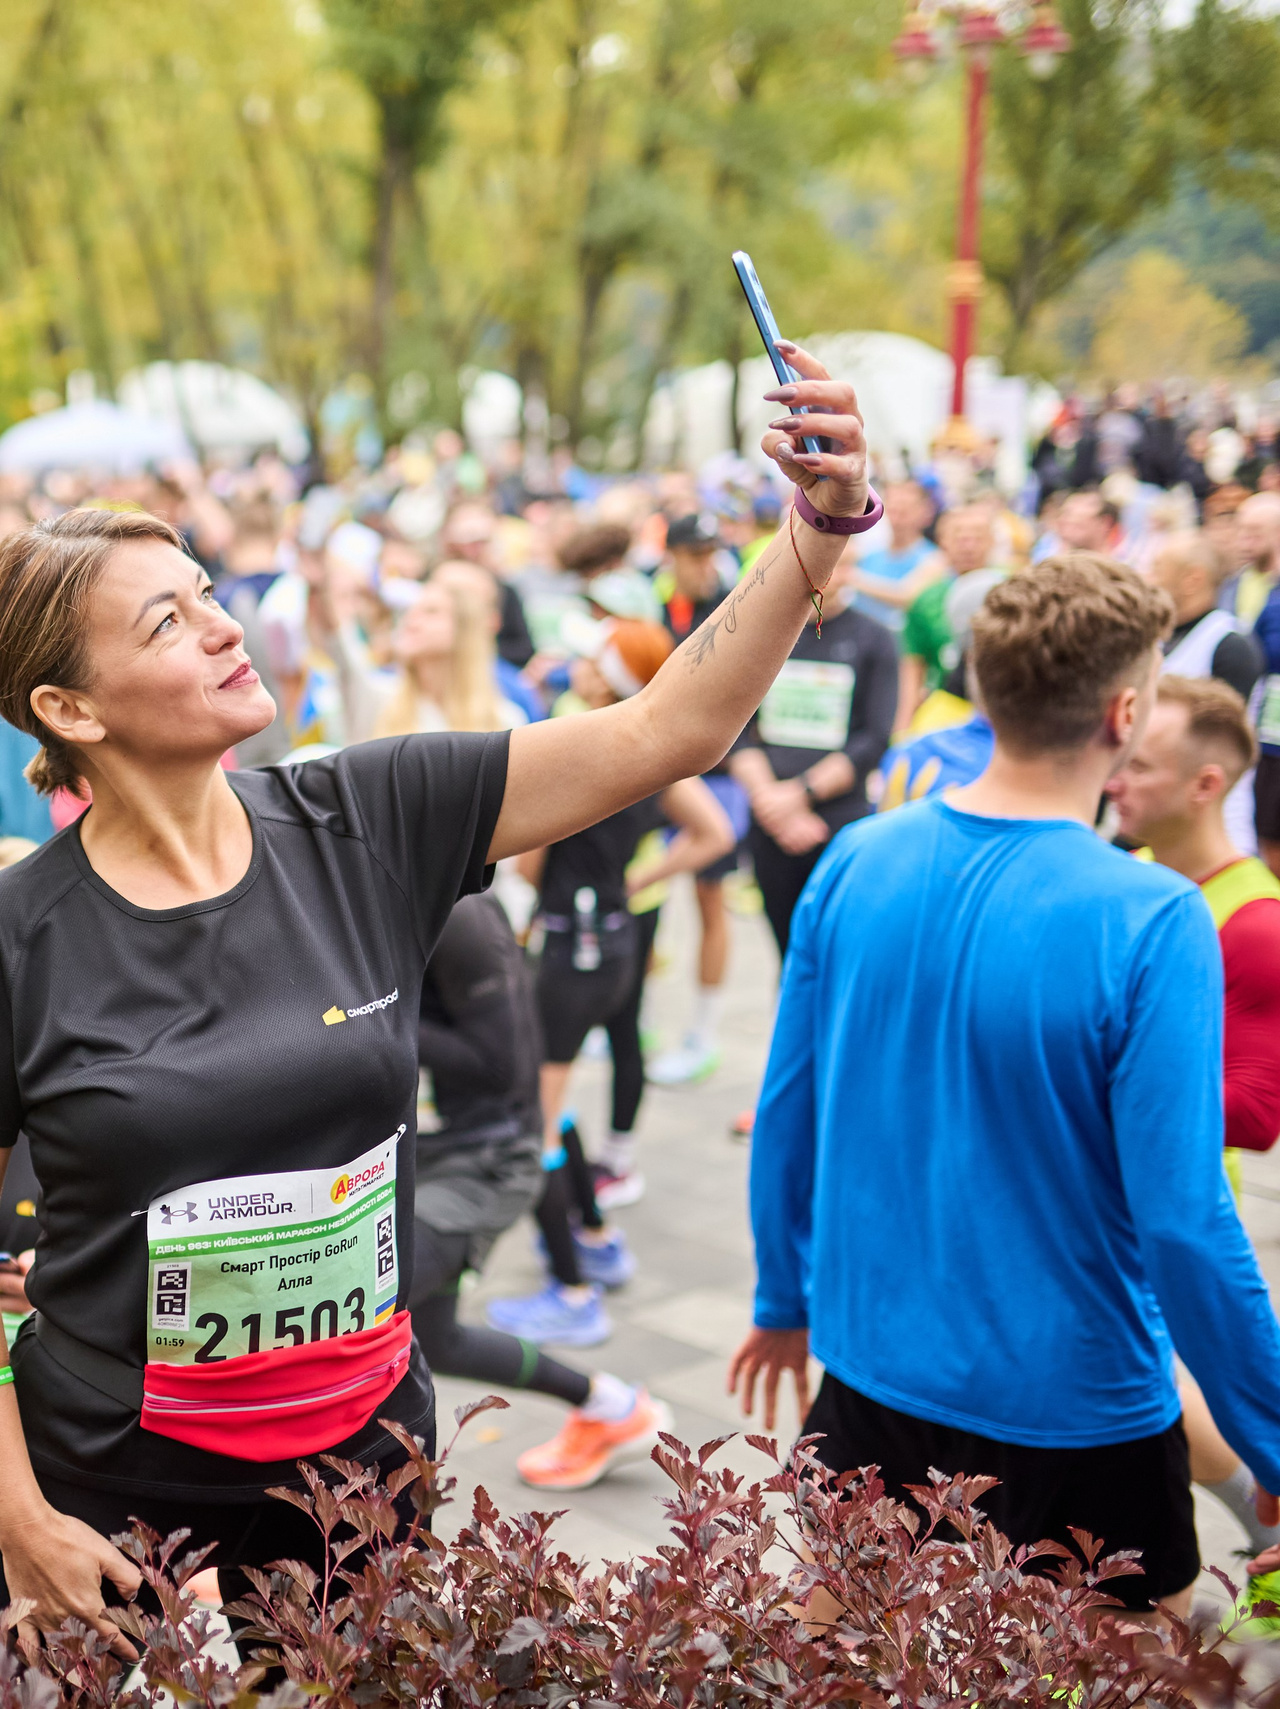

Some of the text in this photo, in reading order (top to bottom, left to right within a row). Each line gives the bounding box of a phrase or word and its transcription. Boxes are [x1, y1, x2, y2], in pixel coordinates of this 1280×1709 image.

[724, 551, 782, 633] Family
[335, 1161, 385, 1200] АВРОРА
[349, 1172, 385, 1198] МУЛЬТИМАРКЕТ
[208, 1192, 275, 1209] UNDER
[155, 1187, 393, 1255] ДЕНЬ 963: КИЇВСЬКИЙ МАРАФОН НЕЗЛАМНОСТІ 2024
[220, 1235, 358, 1275] Смарт Простір GoRun
[277, 1275, 313, 1291] Алла
[155, 1336, 185, 1347] 01:59
[194, 1287, 366, 1364] 21503
